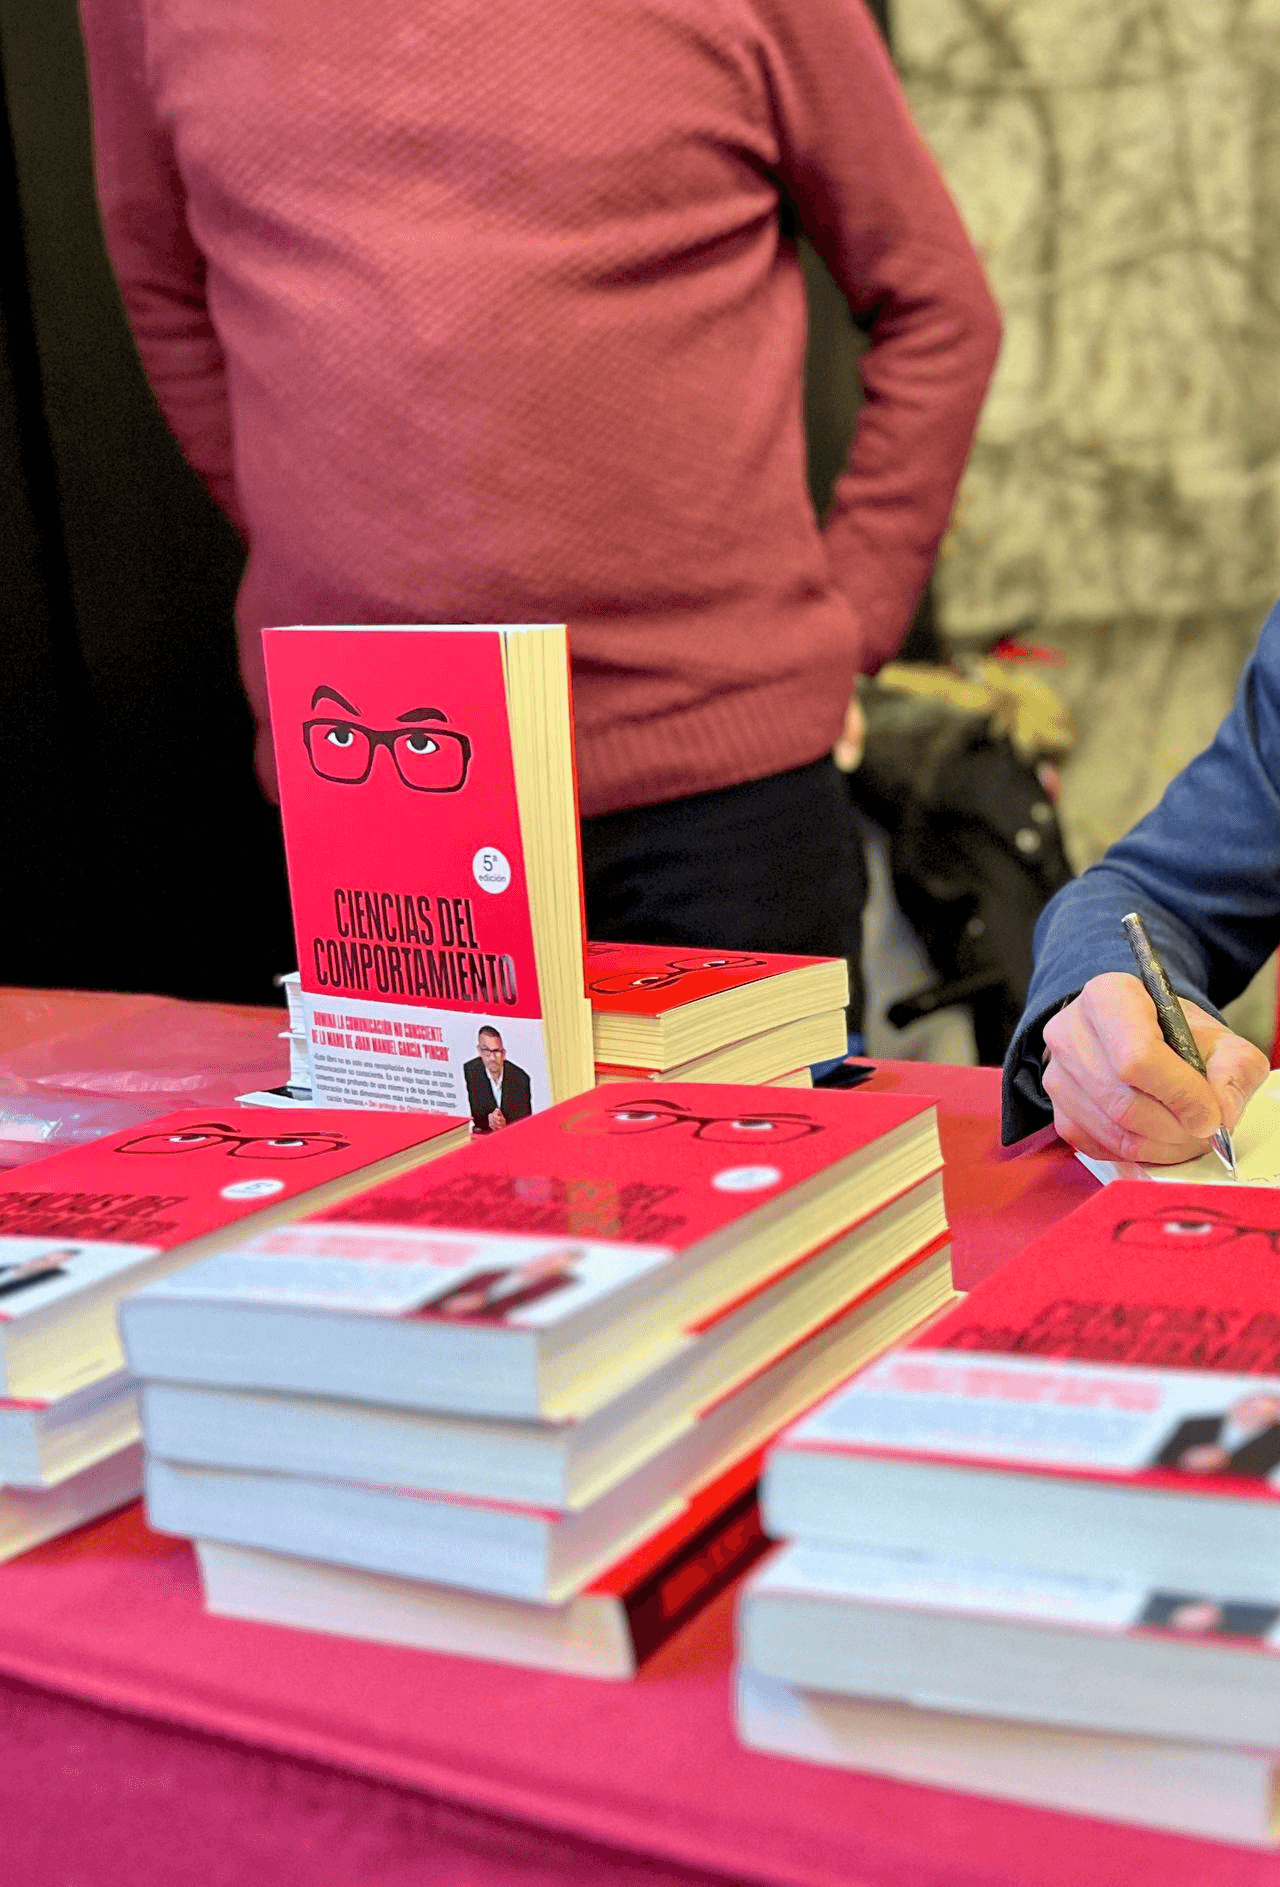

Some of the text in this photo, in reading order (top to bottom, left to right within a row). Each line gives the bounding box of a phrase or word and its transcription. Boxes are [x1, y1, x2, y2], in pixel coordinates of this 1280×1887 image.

[334, 888, 479, 949] CIENCIAS DEL
[313, 938, 517, 1006] COMPORTAMIENTO
[372, 1037, 397, 1055] MANUEL
